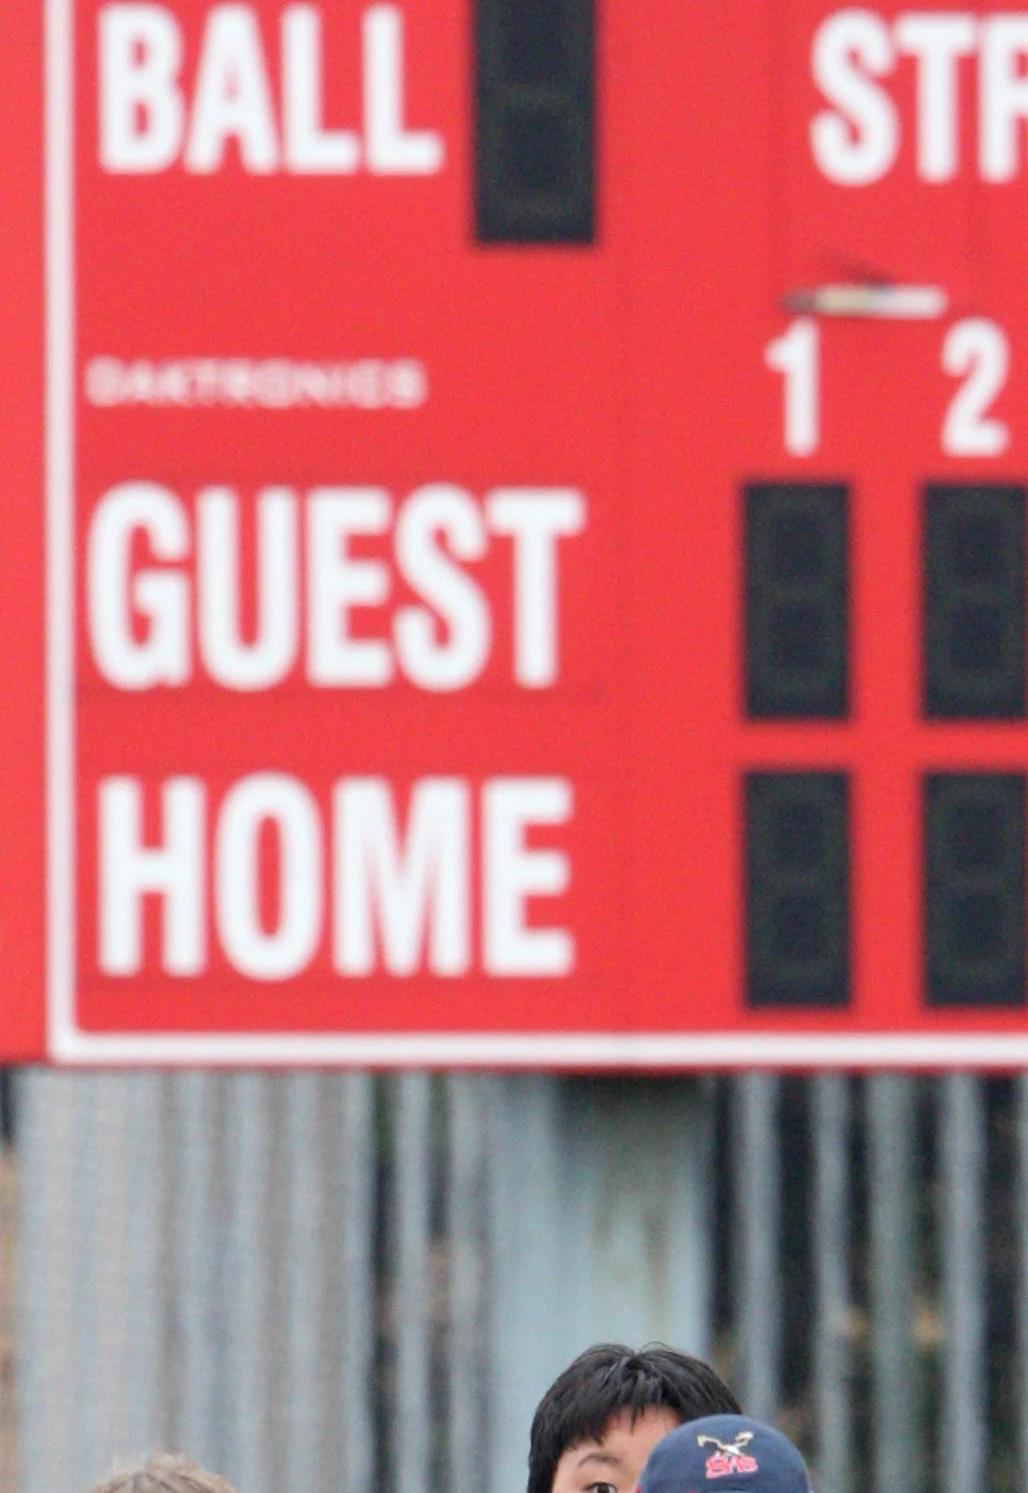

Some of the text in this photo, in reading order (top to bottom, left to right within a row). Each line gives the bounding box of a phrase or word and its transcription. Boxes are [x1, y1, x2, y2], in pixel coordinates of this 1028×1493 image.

[97, 3, 445, 175] BALL
[765, 318, 1009, 457] 1 2
[86, 482, 586, 692] GUEST
[98, 772, 574, 981] HOME
